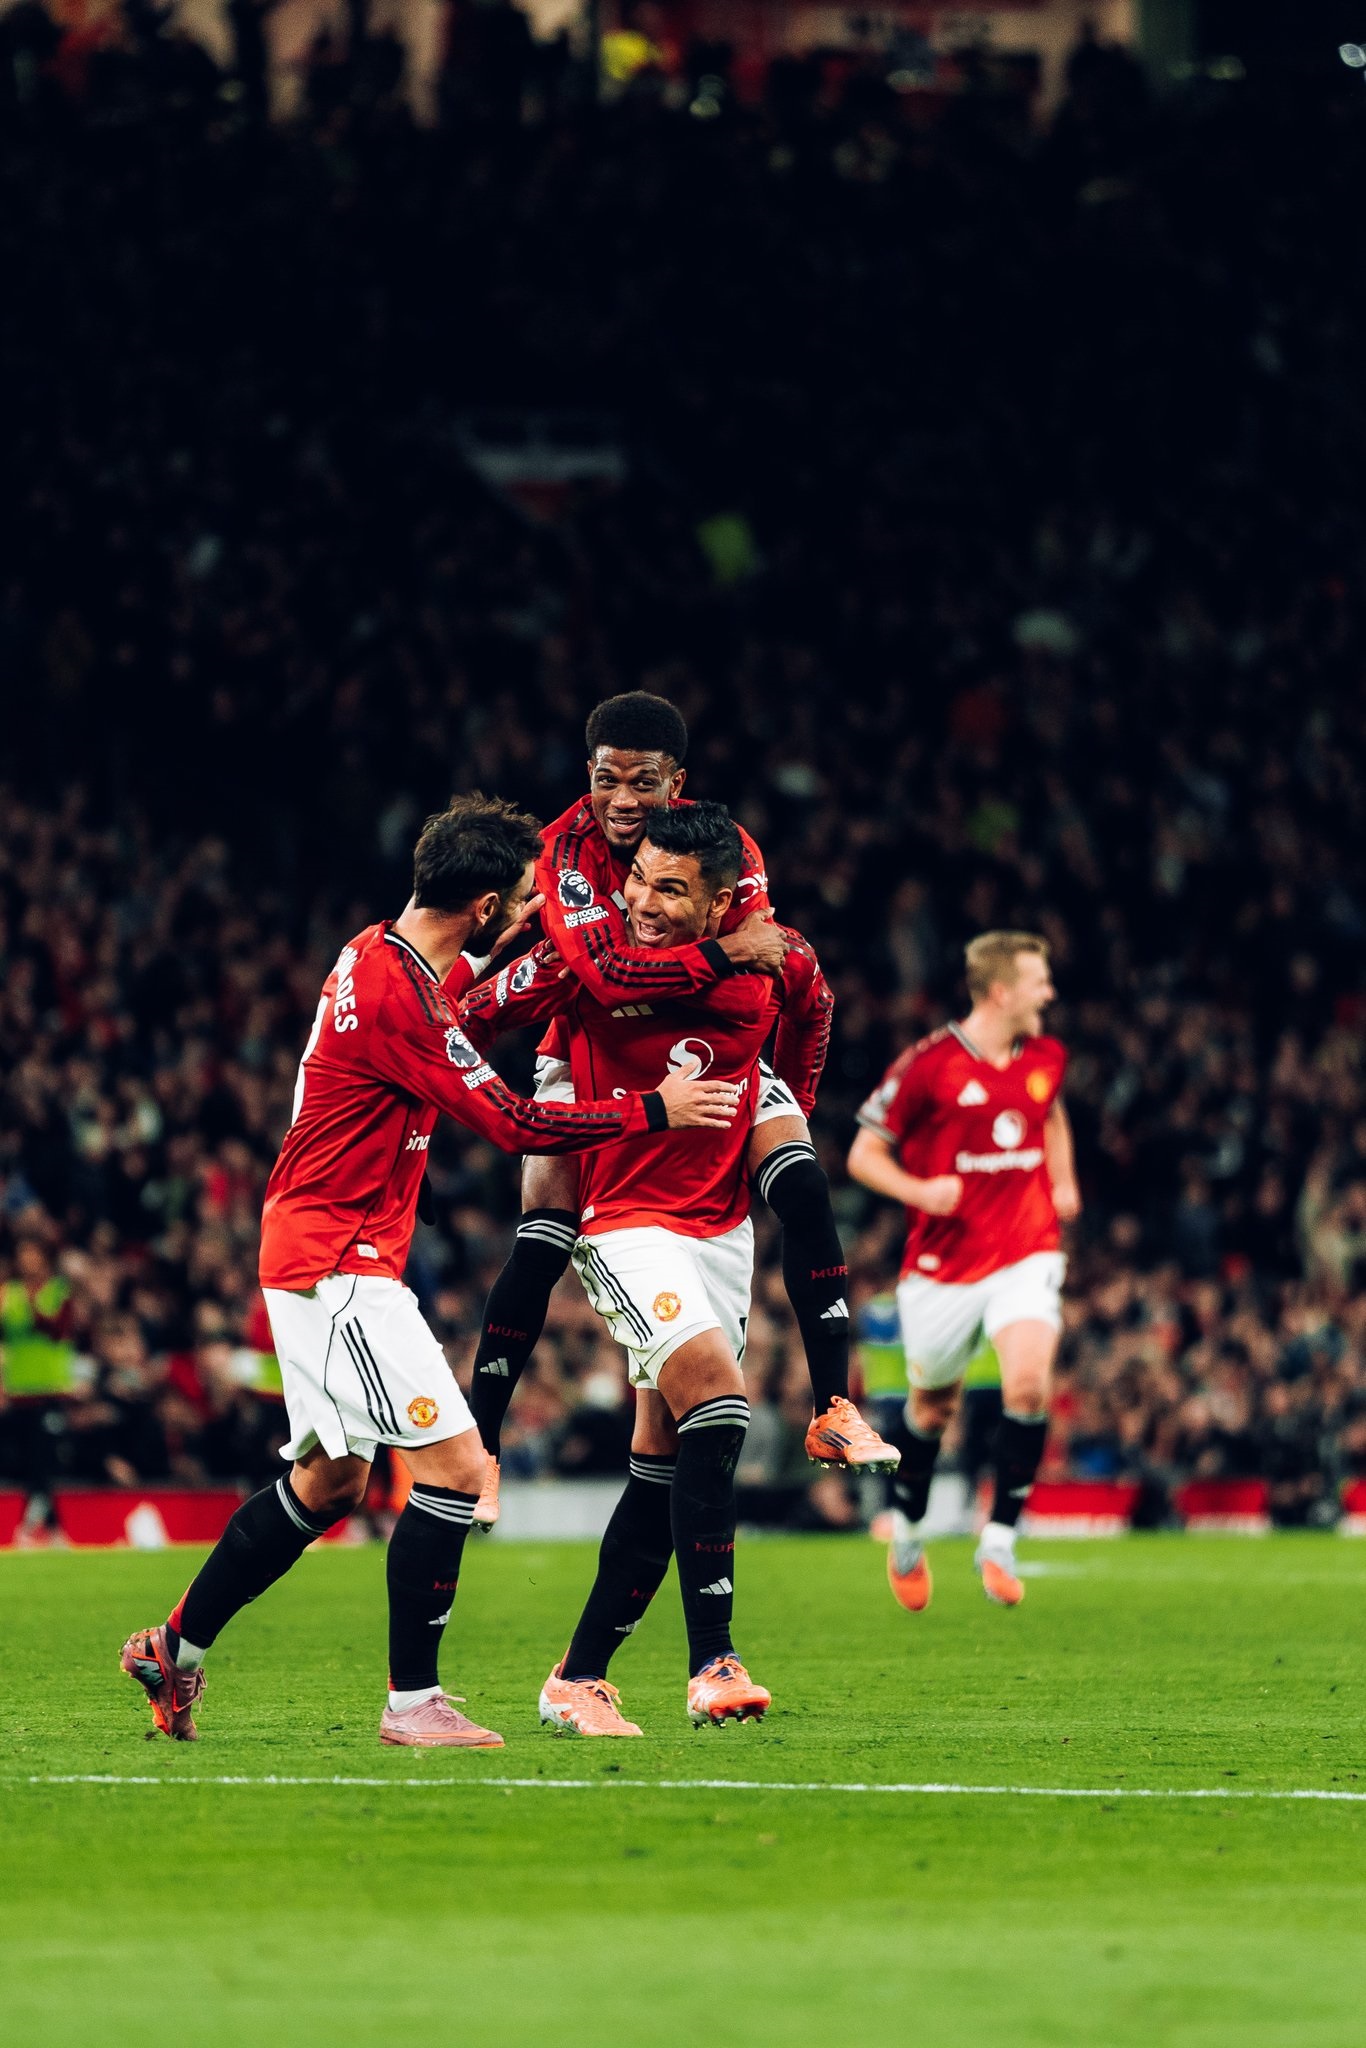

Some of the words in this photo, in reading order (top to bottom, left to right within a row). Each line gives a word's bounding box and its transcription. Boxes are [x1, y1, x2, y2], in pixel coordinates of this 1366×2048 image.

[562, 913, 578, 923] No
[577, 905, 603, 918] room
[579, 910, 610, 926] racism
